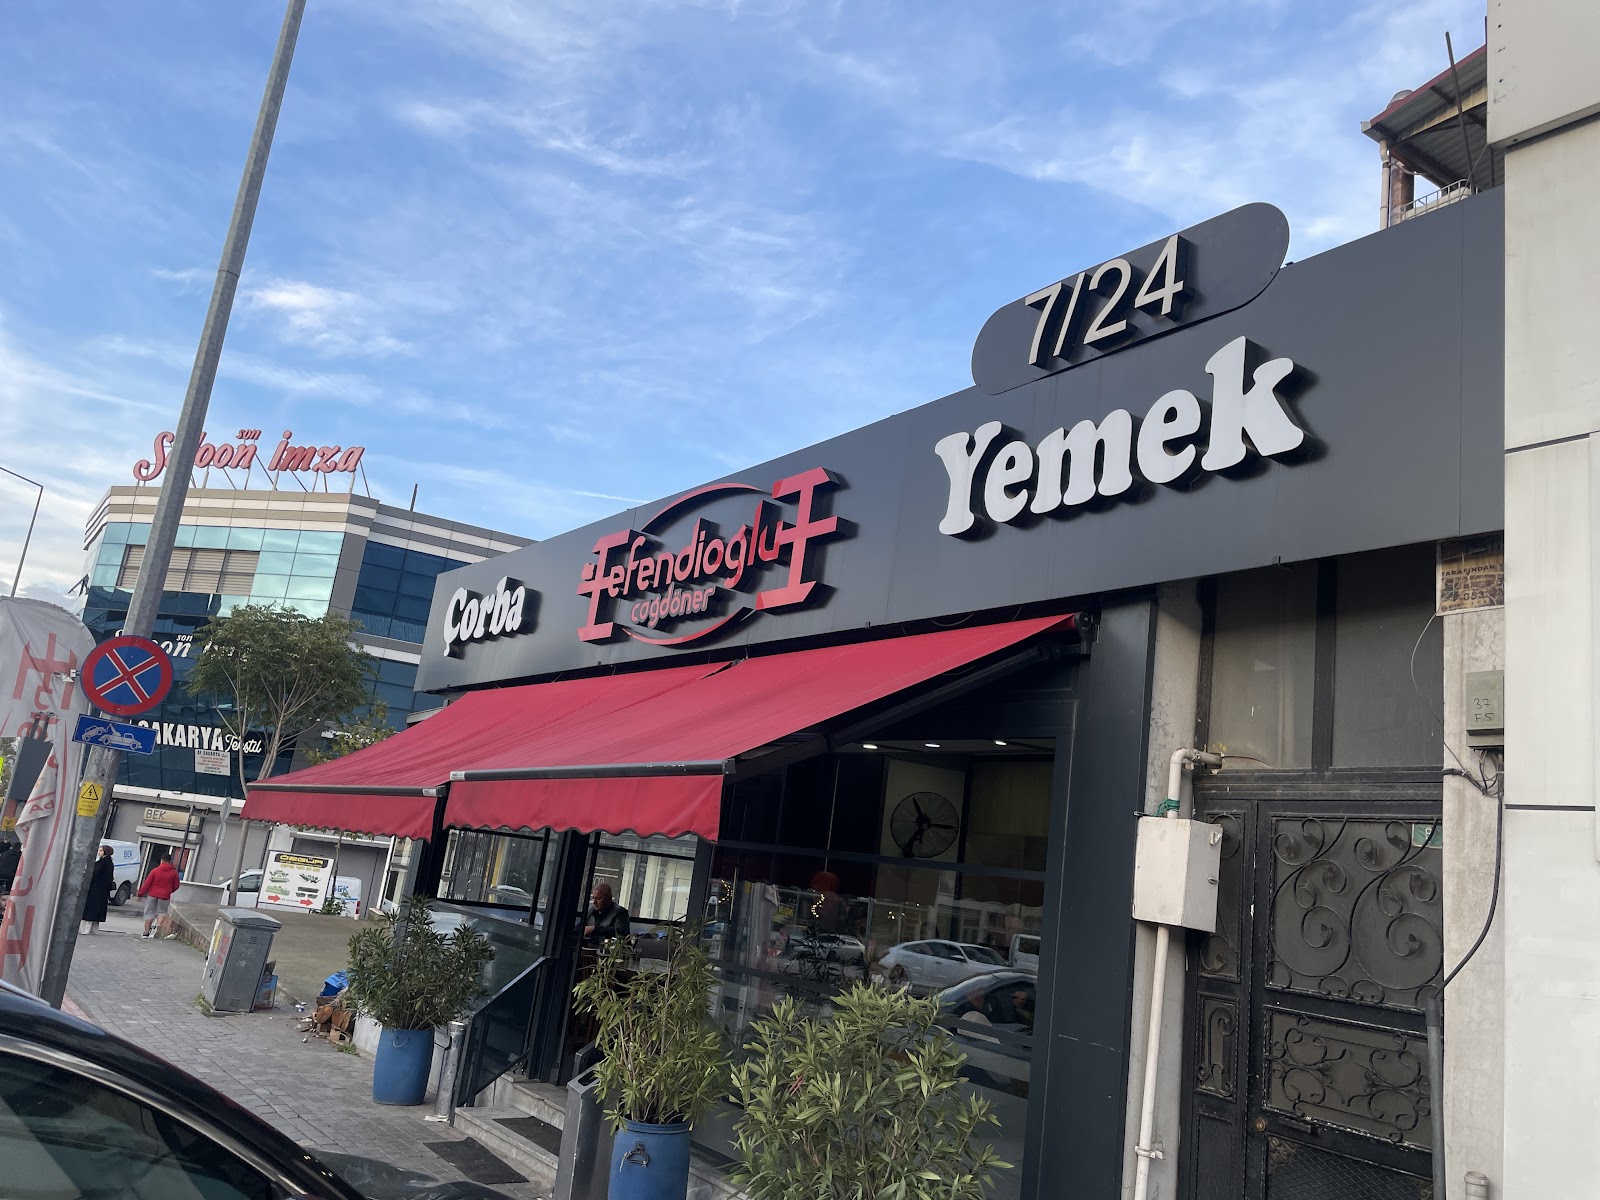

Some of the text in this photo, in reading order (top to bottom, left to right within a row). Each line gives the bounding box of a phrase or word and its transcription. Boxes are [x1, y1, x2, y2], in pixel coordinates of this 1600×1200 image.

[1024, 234, 1184, 365] 7/24
[235, 428, 262, 441] son
[935, 336, 1304, 535] Yemek
[133, 431, 257, 481] Soon
[444, 576, 525, 656] Çorba
[176, 634, 193, 642] son
[145, 809, 167, 820] BEK
[123, 850, 133, 858] BEK
